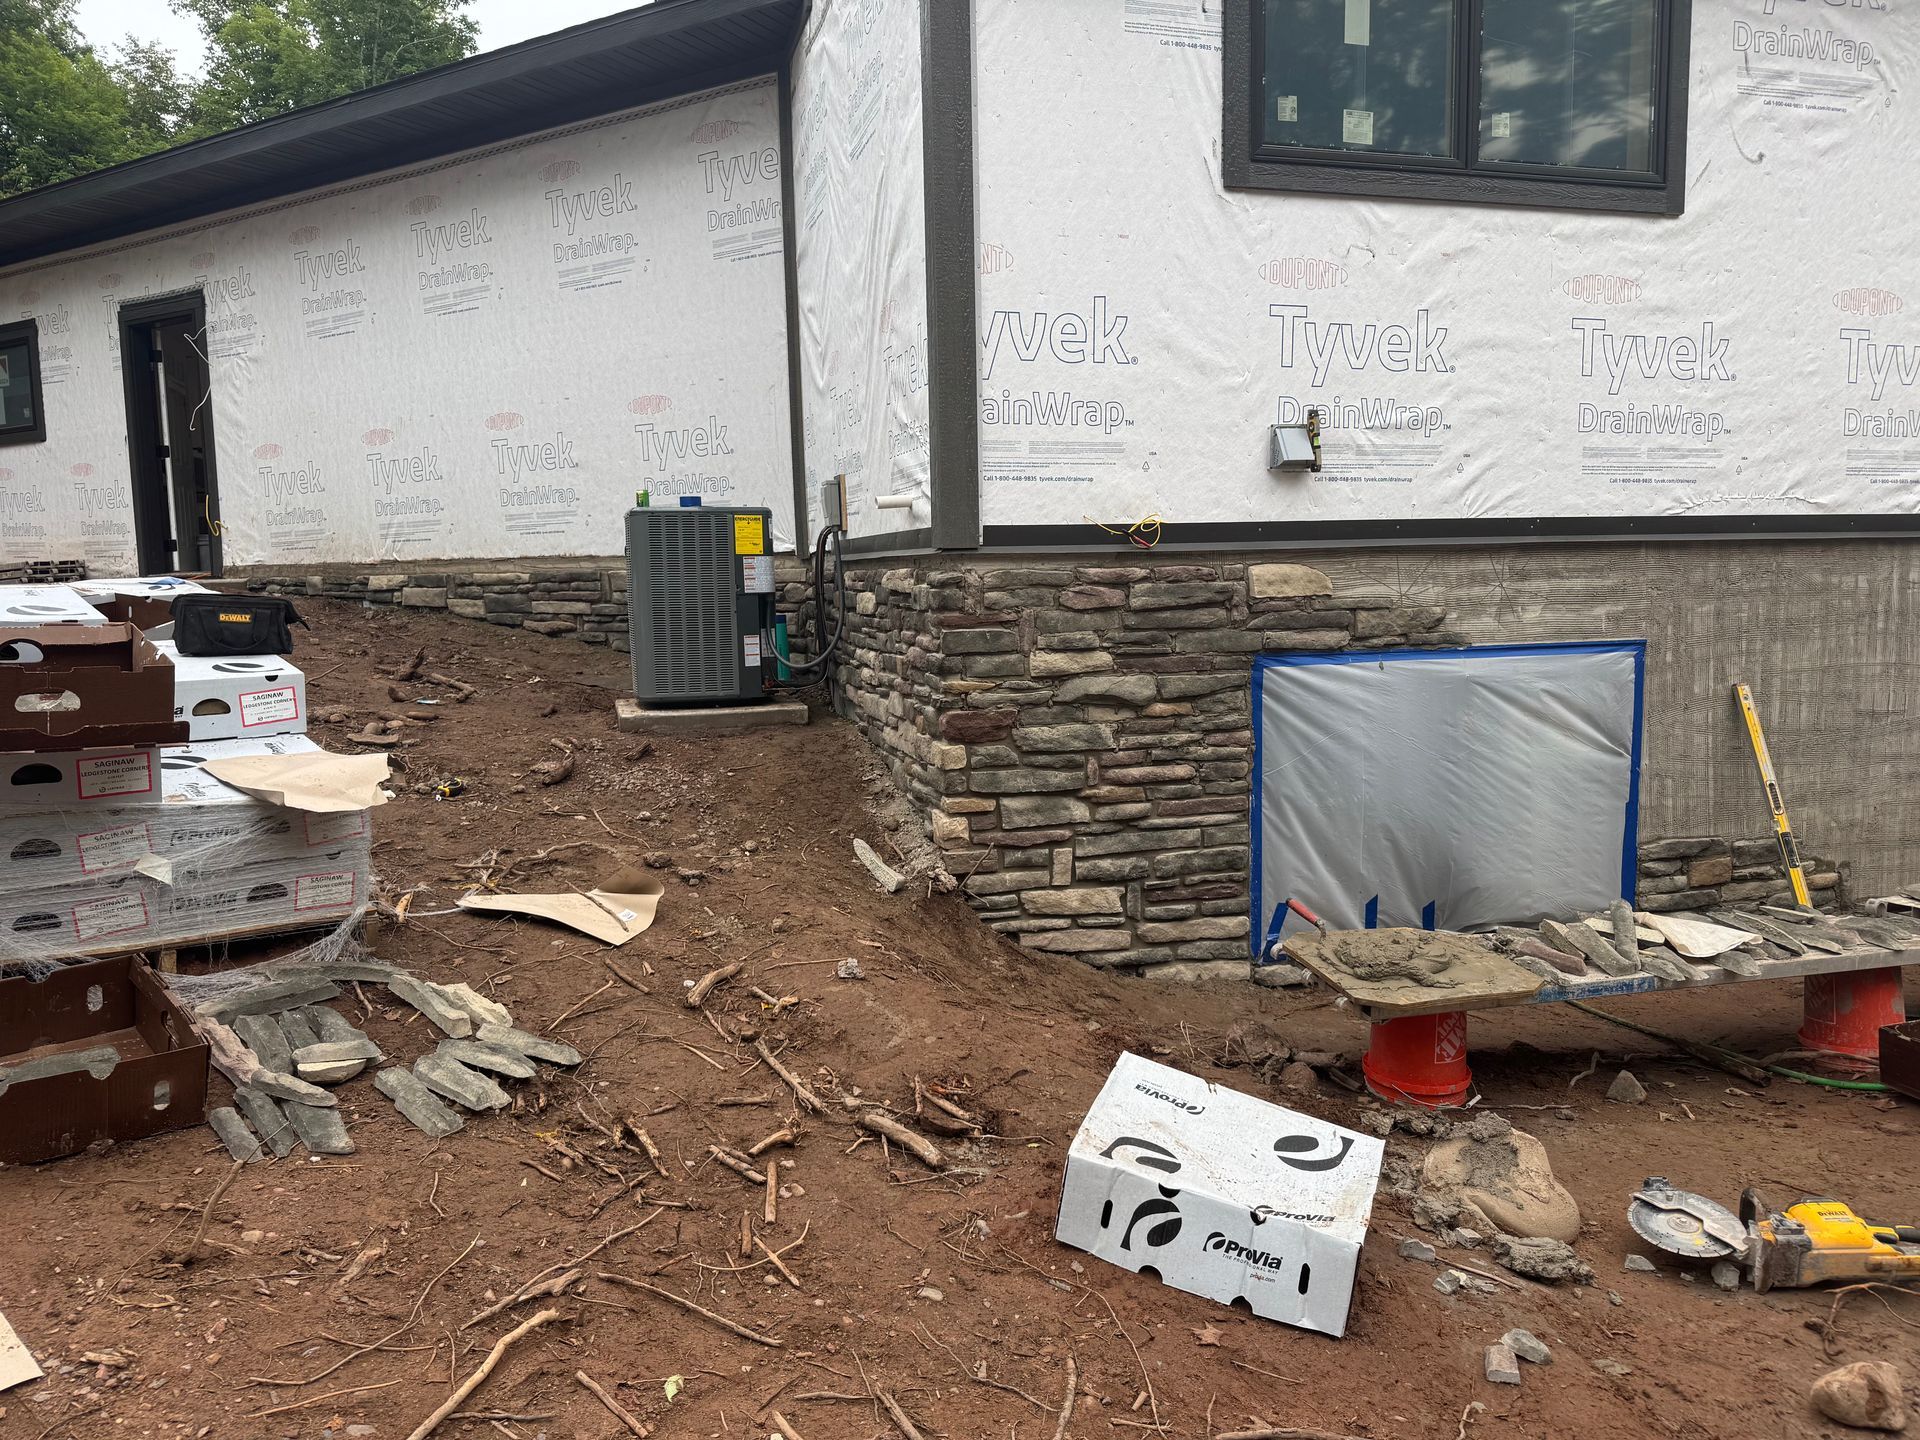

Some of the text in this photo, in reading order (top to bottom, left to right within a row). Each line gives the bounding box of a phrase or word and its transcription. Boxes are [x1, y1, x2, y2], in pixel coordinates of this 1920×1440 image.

[1733, 20, 1874, 71] DrainWrap
[698, 147, 779, 202] Tyve
[545, 173, 635, 236] Tyvek
[707, 197, 782, 232] DrainWr
[411, 208, 489, 265] Tyvek
[553, 232, 635, 263] DrainWrap
[294, 239, 363, 291] Tyvek
[418, 261, 490, 290] DrainWrap
[1268, 258, 1341, 290] DUPONT
[302, 288, 364, 315] DrainWrap
[1571, 274, 1635, 305] DUPONT
[1839, 287, 1897, 317] DUPONT
[206, 313, 253, 335] rainWrap
[982, 296, 1130, 380] yvek
[1270, 304, 1449, 387] Tyvek
[1572, 317, 1731, 396] Tyvek
[1840, 328, 1920, 402] Tyv
[982, 389, 1125, 434] ainWrap
[1277, 395, 1443, 438] DrainWrap
[1578, 402, 1724, 442] DrainWrap
[1843, 407, 1920, 438] Drain
[491, 432, 576, 483] Tyvek
[635, 415, 731, 472] Tyvek
[259, 461, 324, 505] Tyvek
[367, 447, 441, 494] Tyvek
[644, 472, 730, 497] DrainWrap
[1039, 475, 1094, 484] tyvek.com/drainwrap
[74, 480, 127, 518] Tyvek
[375, 496, 441, 517] DrainWrap
[500, 485, 577, 508] DrainWrap
[266, 506, 324, 527] DrainWrap
[219, 613, 251, 622] DEWALT
[252, 692, 284, 701] SAGINAW
[81, 768, 120, 777] LEDGESTONE
[94, 758, 135, 768] SAGINAW
[94, 828, 134, 842] SAGINAW
[310, 875, 344, 884] SAGINAW
[89, 897, 129, 911] SAGINAW
[1134, 1083, 1187, 1110] ProVia
[1272, 1210, 1336, 1222] ProVia
[1222, 1253, 1233, 1261] THE
[1223, 1239, 1284, 1271] ProVia
